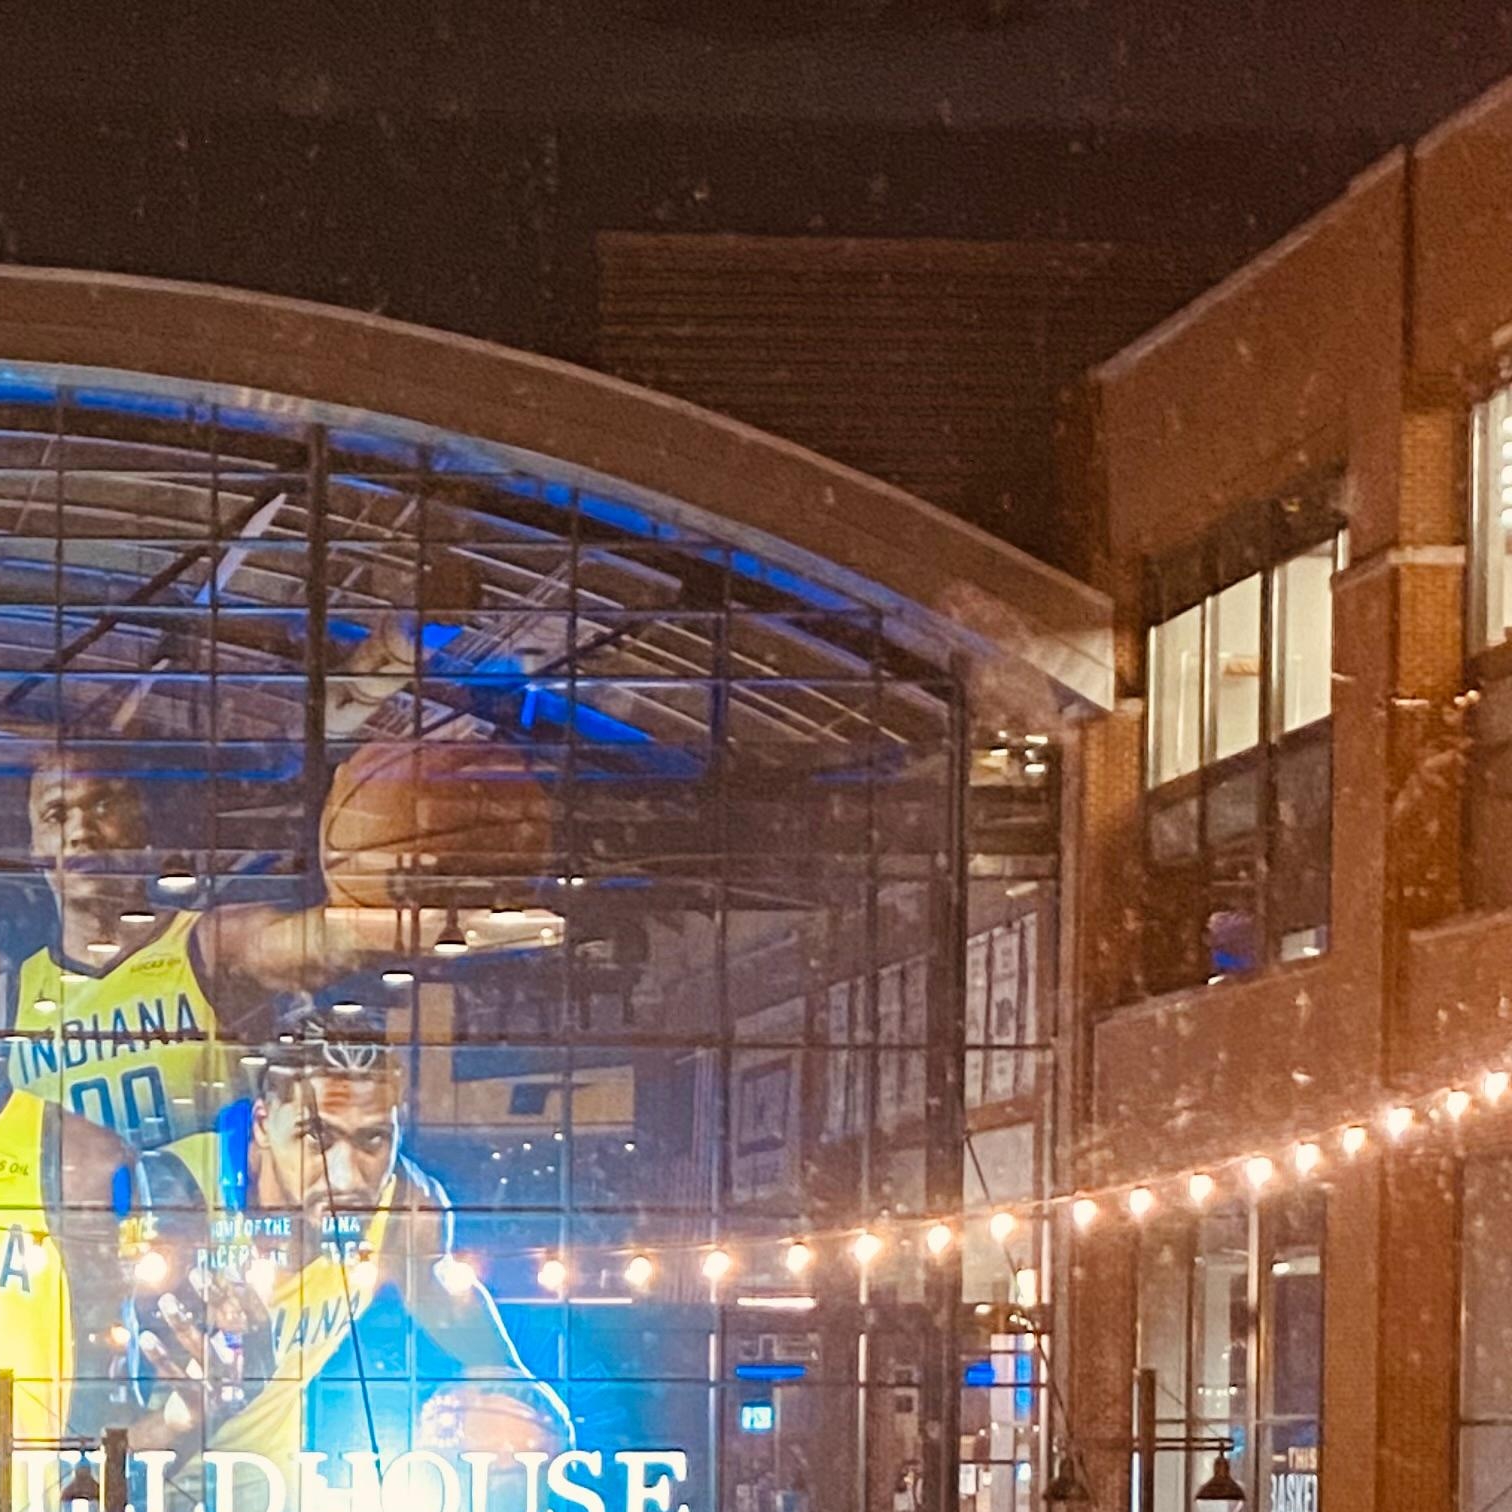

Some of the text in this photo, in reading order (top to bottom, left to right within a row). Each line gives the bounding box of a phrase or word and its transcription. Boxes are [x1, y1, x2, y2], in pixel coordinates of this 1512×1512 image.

[17, 992, 201, 1085] INDIANA
[70, 1066, 172, 1150] 00
[9, 1163, 30, 1176] OIL
[263, 1216, 292, 1237] THE
